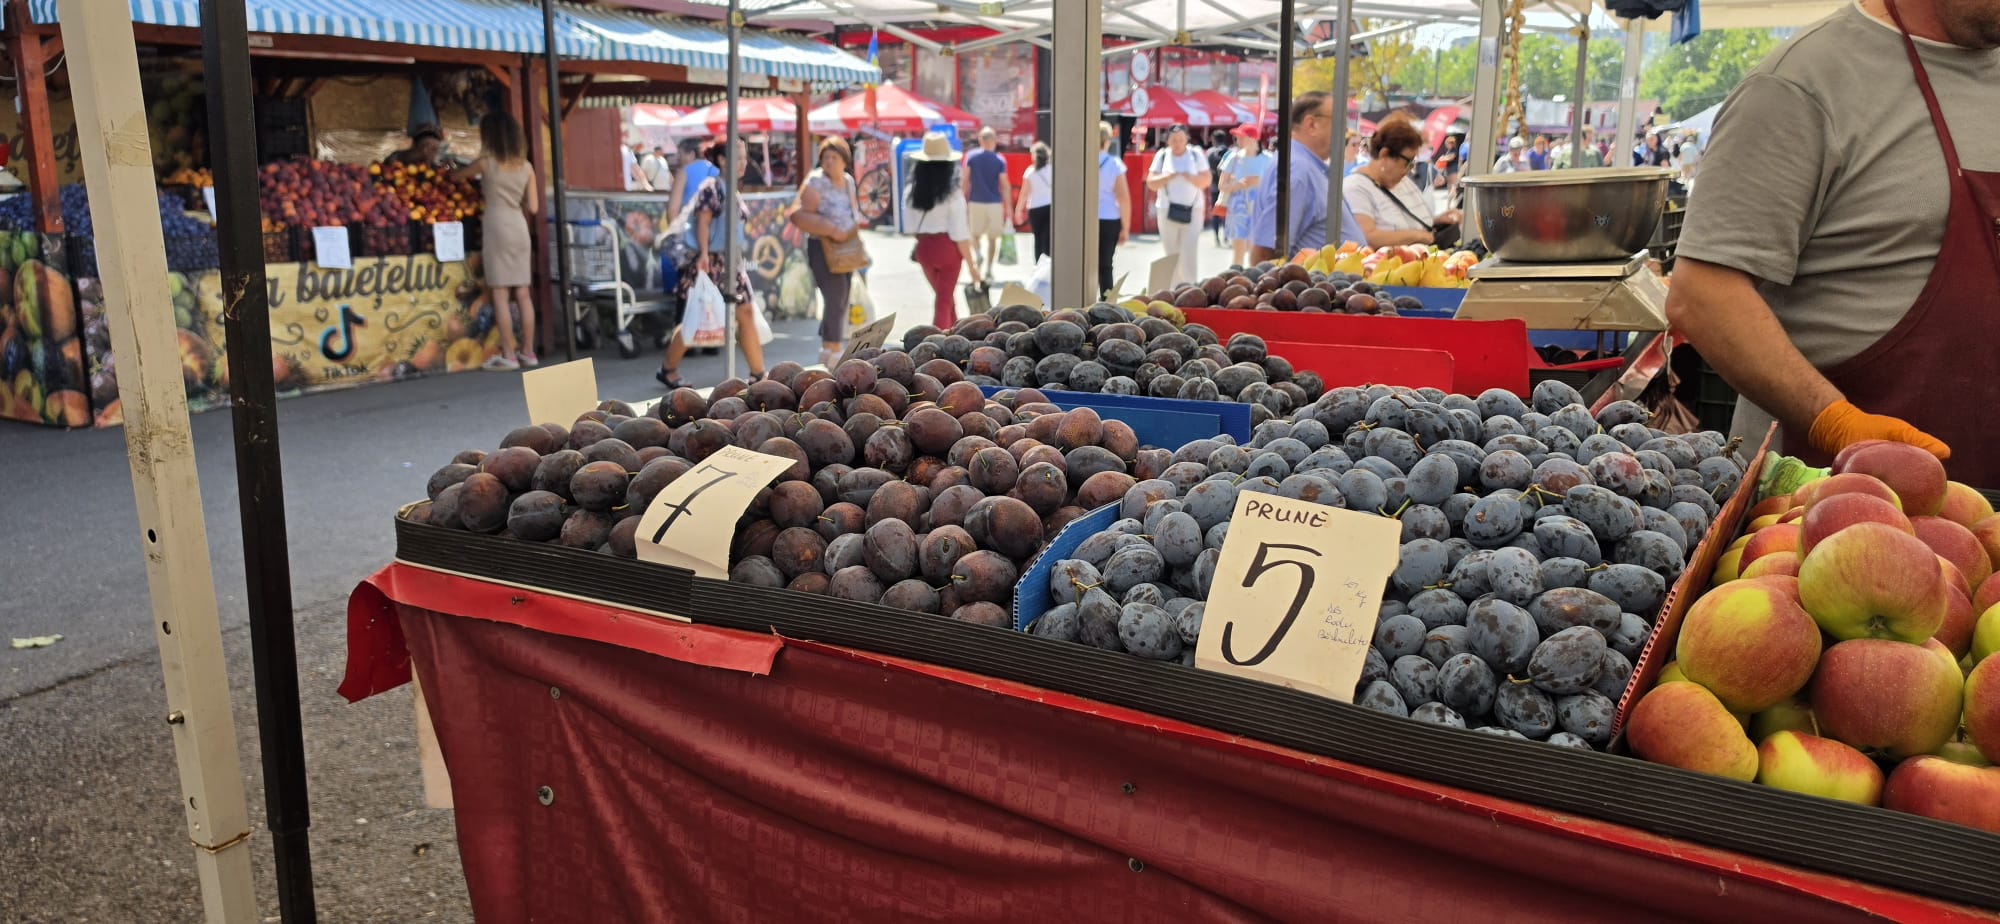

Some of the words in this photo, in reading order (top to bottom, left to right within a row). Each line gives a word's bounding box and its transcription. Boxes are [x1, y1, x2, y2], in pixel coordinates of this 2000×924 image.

[652, 464, 738, 544] 7
[1245, 500, 1329, 528] PRUNE
[1221, 542, 1323, 666] 5
